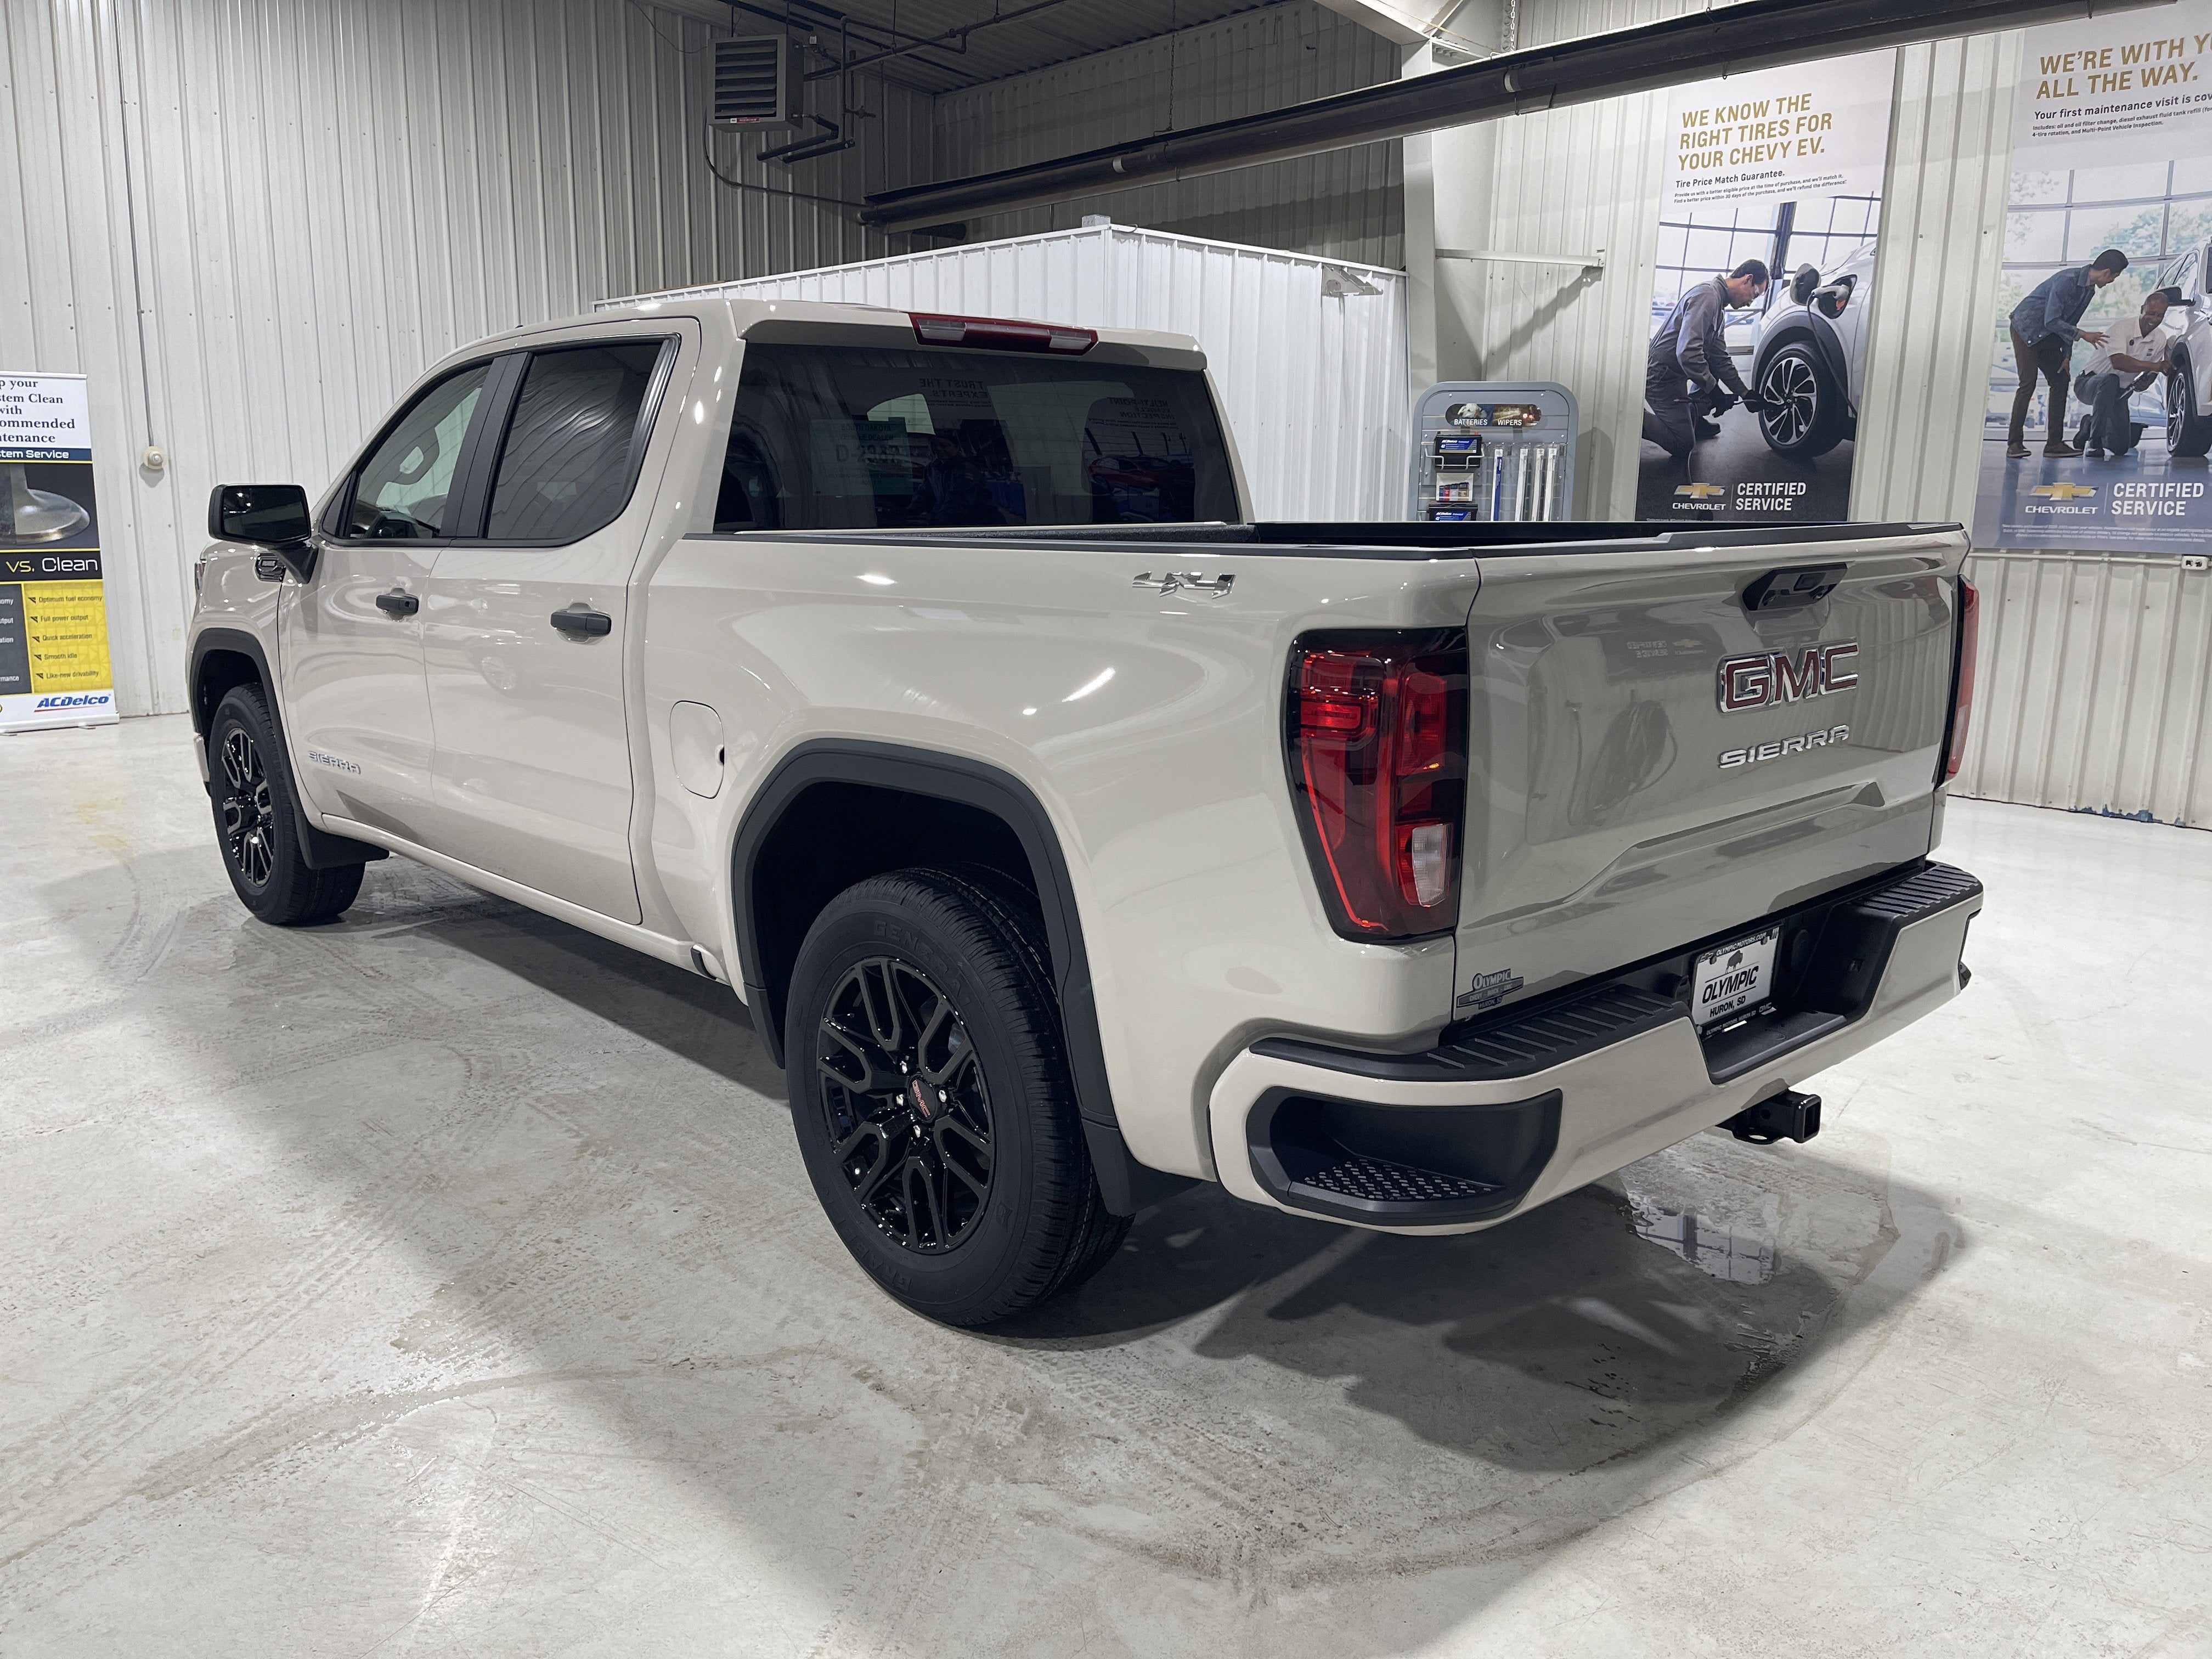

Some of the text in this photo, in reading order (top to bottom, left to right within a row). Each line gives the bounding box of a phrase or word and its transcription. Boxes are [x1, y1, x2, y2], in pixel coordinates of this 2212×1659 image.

[2040, 48, 2113, 75] WE'RE
[2120, 37, 2185, 65] WITH
[2036, 61, 2198, 99] ALL THE WAY.
[1682, 93, 1812, 128] WE KNOW THE
[2034, 111, 2057, 120] Your
[2059, 108, 2082, 118] first
[2084, 101, 2152, 115] maintenance
[2155, 96, 2179, 107] visit
[2182, 94, 2191, 104] is
[1679, 112, 1832, 150] RIGHT TIRES FOR
[1678, 136, 1825, 171] YOUR CHEVY EV.
[1675, 171, 1785, 188] Tire Price Match Guarantee.
[9, 380, 38, 390] your
[0, 393, 63, 404] tem Clean
[0, 418, 75, 428] ommended
[0, 433, 56, 443] tenance
[0, 450, 69, 459] tem Service
[1737, 482, 1807, 496] CERTIFIED
[2113, 482, 2204, 498] CERTIFIED
[1672, 502, 1726, 511] CHEVROLET
[1735, 498, 1792, 511] SERVICE
[2025, 505, 2098, 515] CHEVROLET
[2111, 500, 2187, 516] SERVICE
[42, 556, 98, 572] Clean
[1720, 641, 1859, 713] GMC
[37, 695, 110, 708] ACDelco
[1718, 724, 1850, 769] SIERRA
[308, 750, 362, 775] SIERRA
[1473, 970, 1511, 989] OLYMPIC
[1702, 966, 1759, 1004] OLYMPIC
[1709, 995, 1746, 1018] HURON, SD
[912, 1080, 931, 1118] GMC
